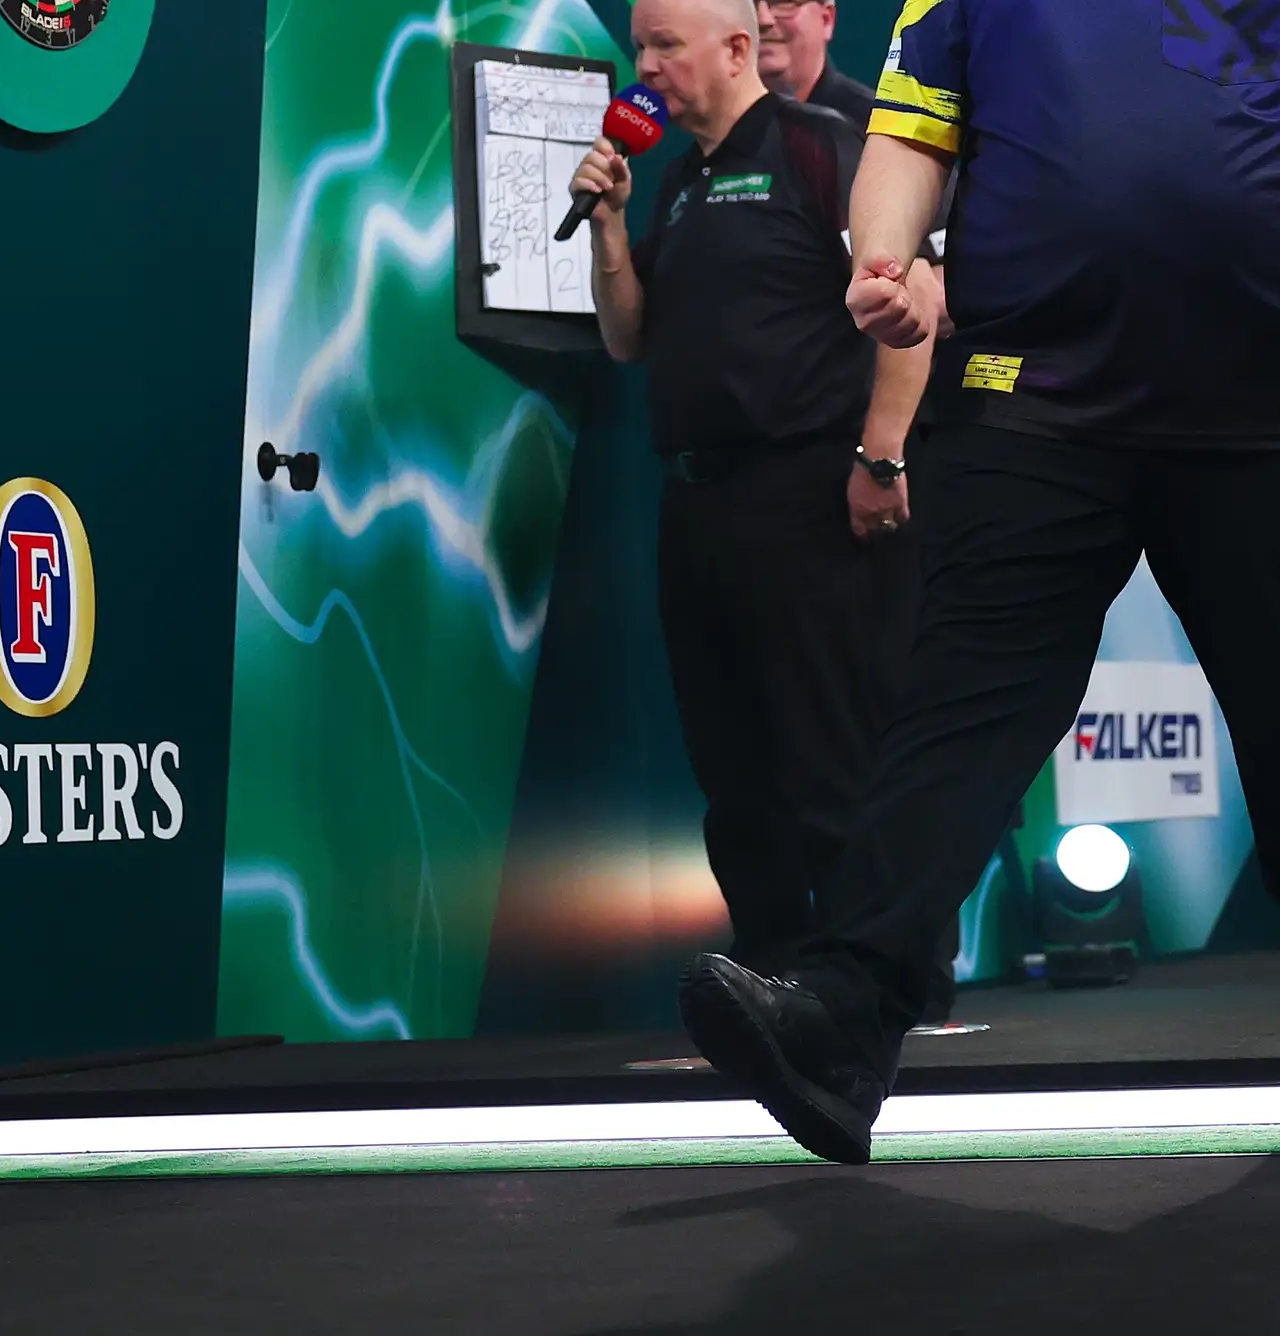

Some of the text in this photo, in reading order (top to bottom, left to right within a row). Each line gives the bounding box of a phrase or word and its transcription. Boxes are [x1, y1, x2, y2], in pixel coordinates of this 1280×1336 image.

[632, 93, 659, 115] sky
[614, 105, 655, 137] sports
[7, 530, 61, 663] F
